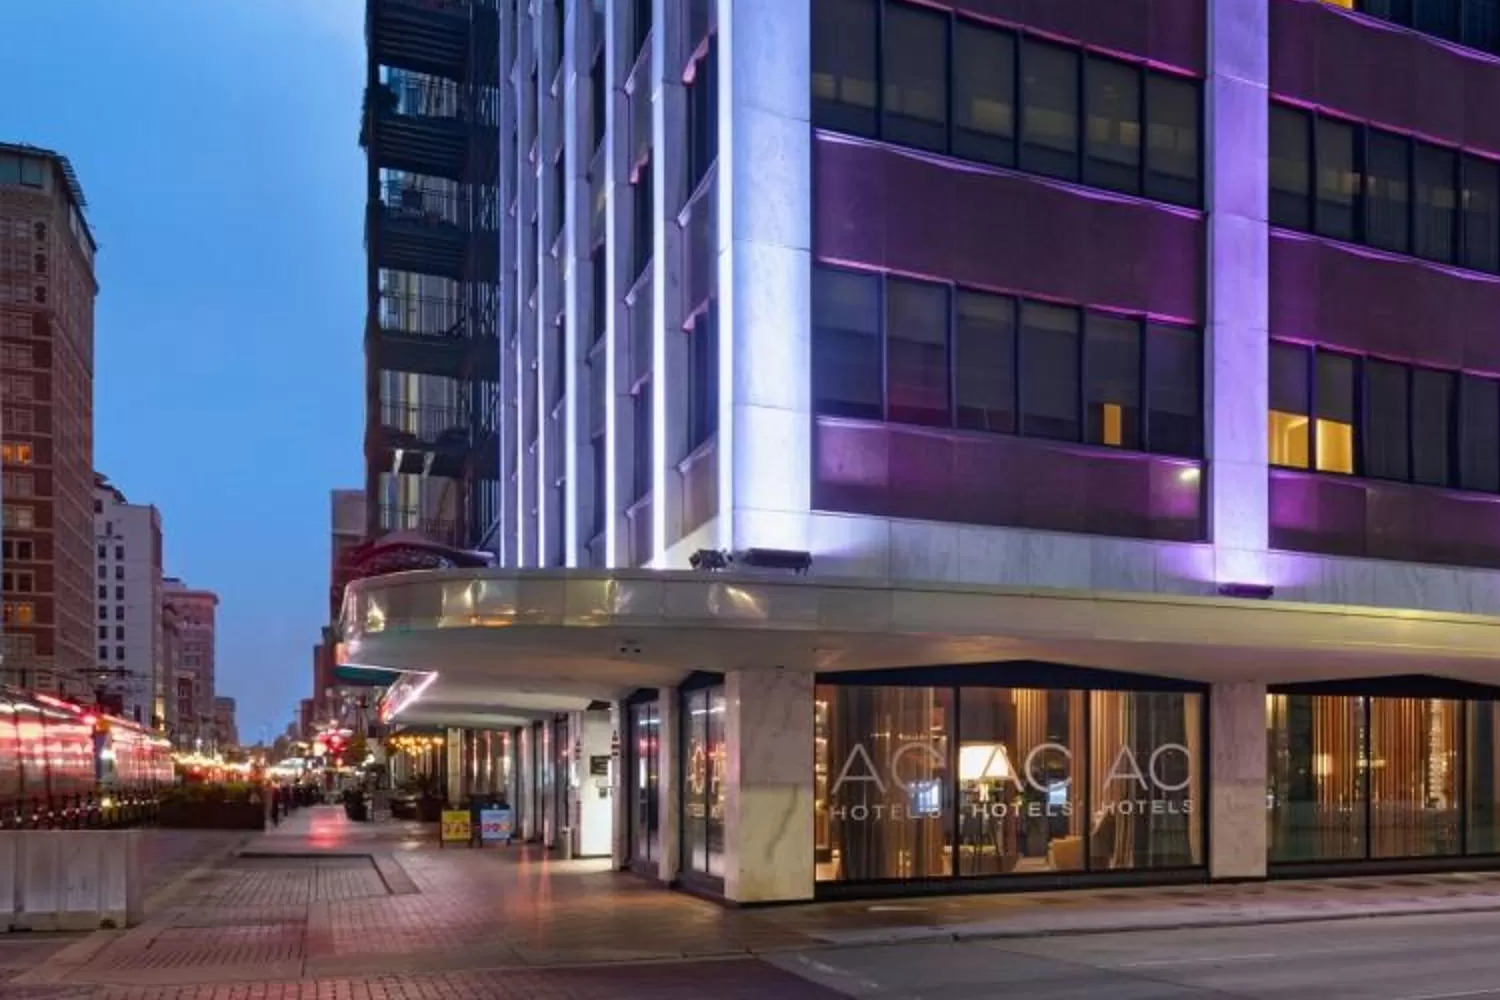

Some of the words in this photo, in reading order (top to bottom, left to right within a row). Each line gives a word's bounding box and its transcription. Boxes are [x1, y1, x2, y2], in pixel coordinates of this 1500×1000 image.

[976, 744, 1072, 792] AC
[1103, 743, 1192, 791] AC
[829, 804, 941, 821] HOTELS
[972, 801, 1073, 818] HOTELS
[1101, 799, 1193, 815] HOTELS
